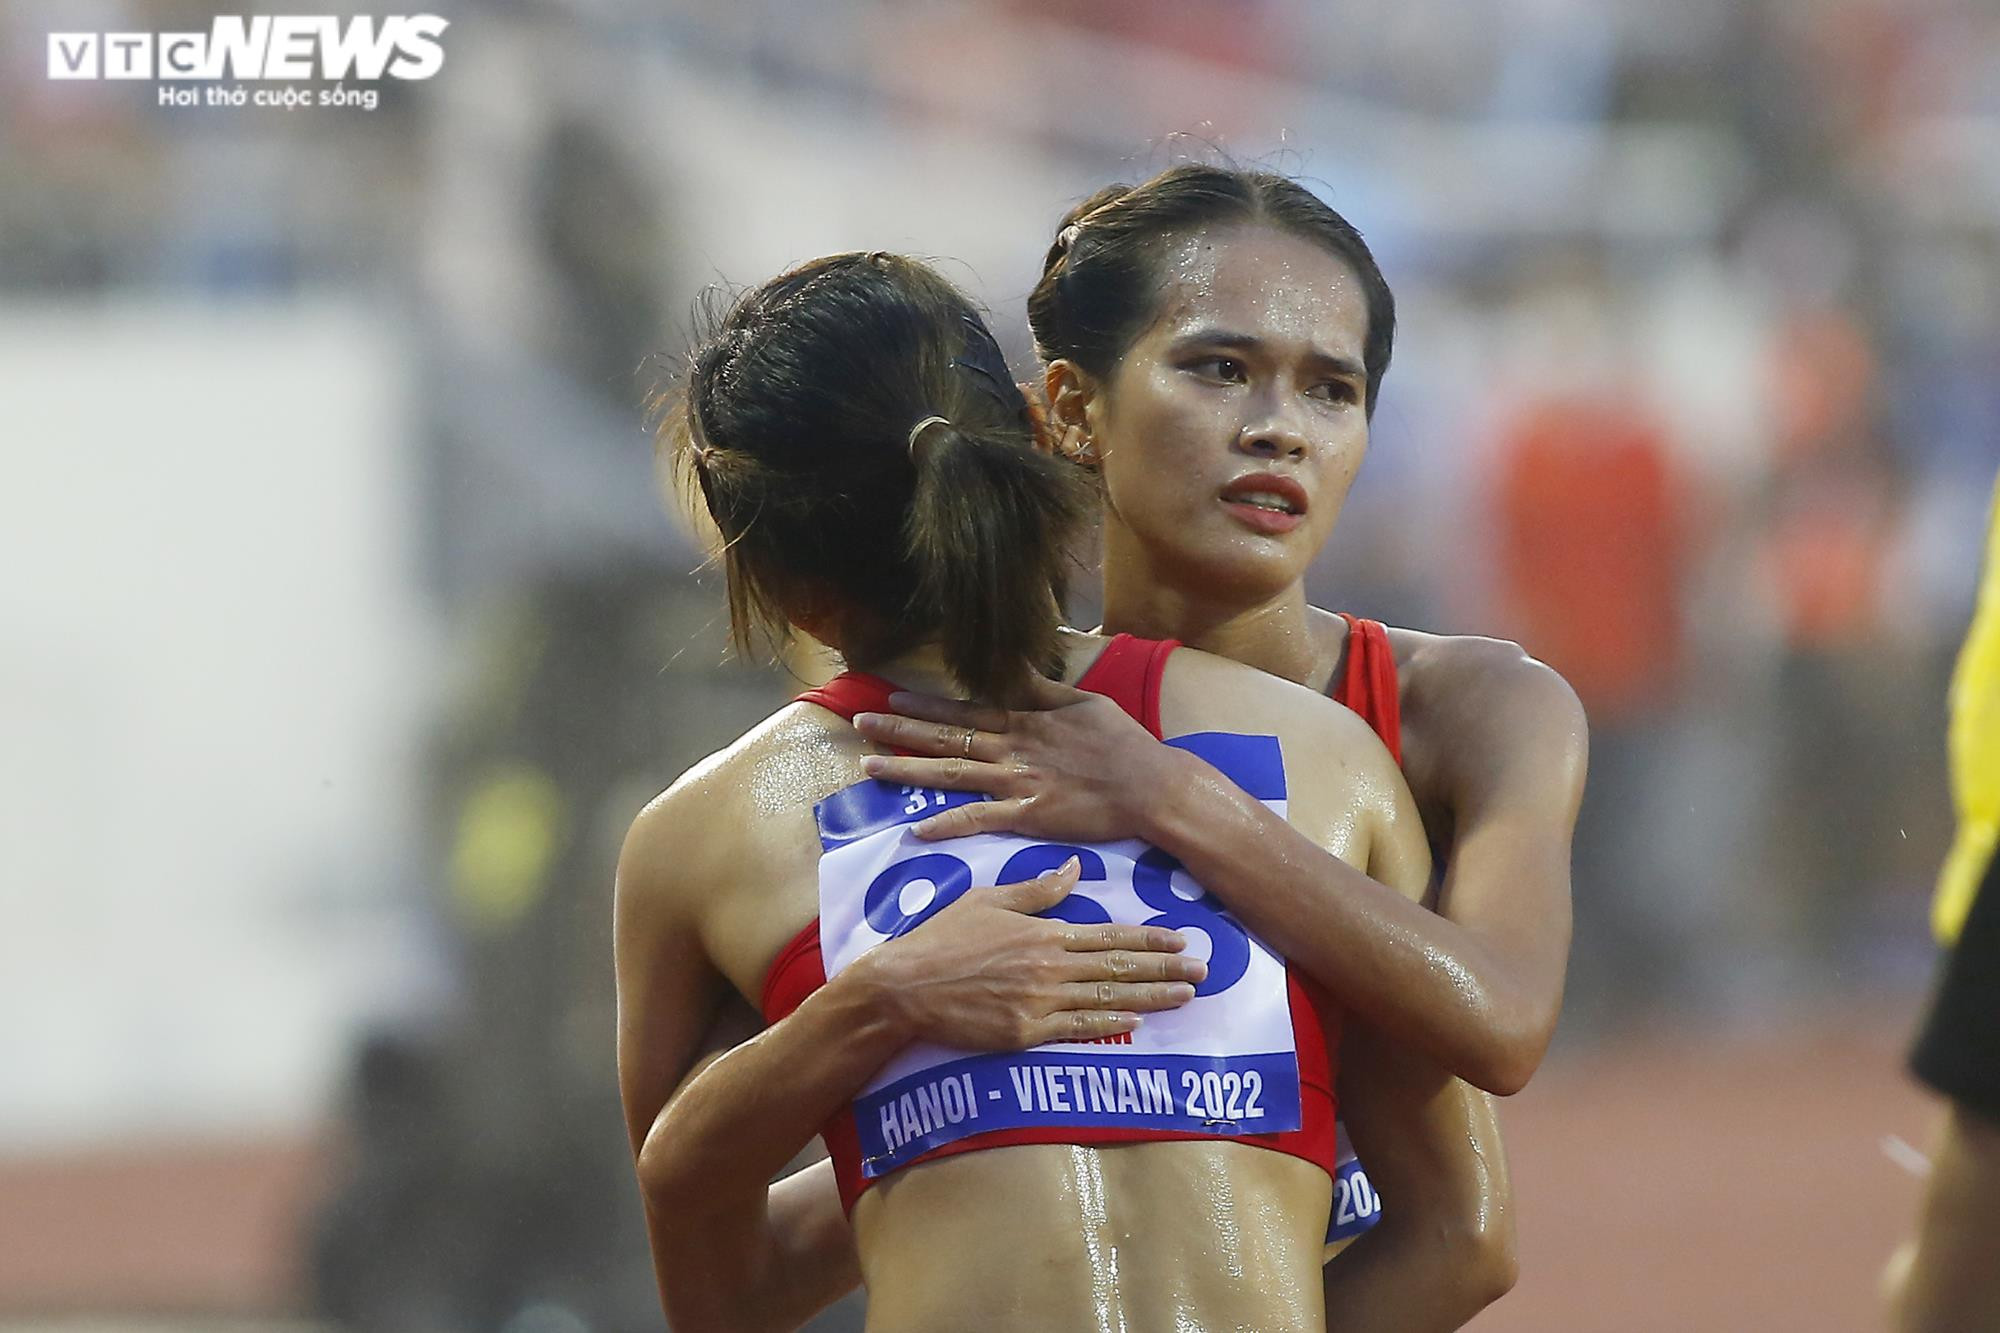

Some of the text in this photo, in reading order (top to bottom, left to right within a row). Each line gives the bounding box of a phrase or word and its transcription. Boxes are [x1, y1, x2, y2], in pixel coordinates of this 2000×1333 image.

[879, 1073, 978, 1151] HANOI
[1009, 1066, 1175, 1115] VIETNAM
[1181, 1070, 1264, 1120] 2022
[1334, 1171, 1381, 1226] 20
